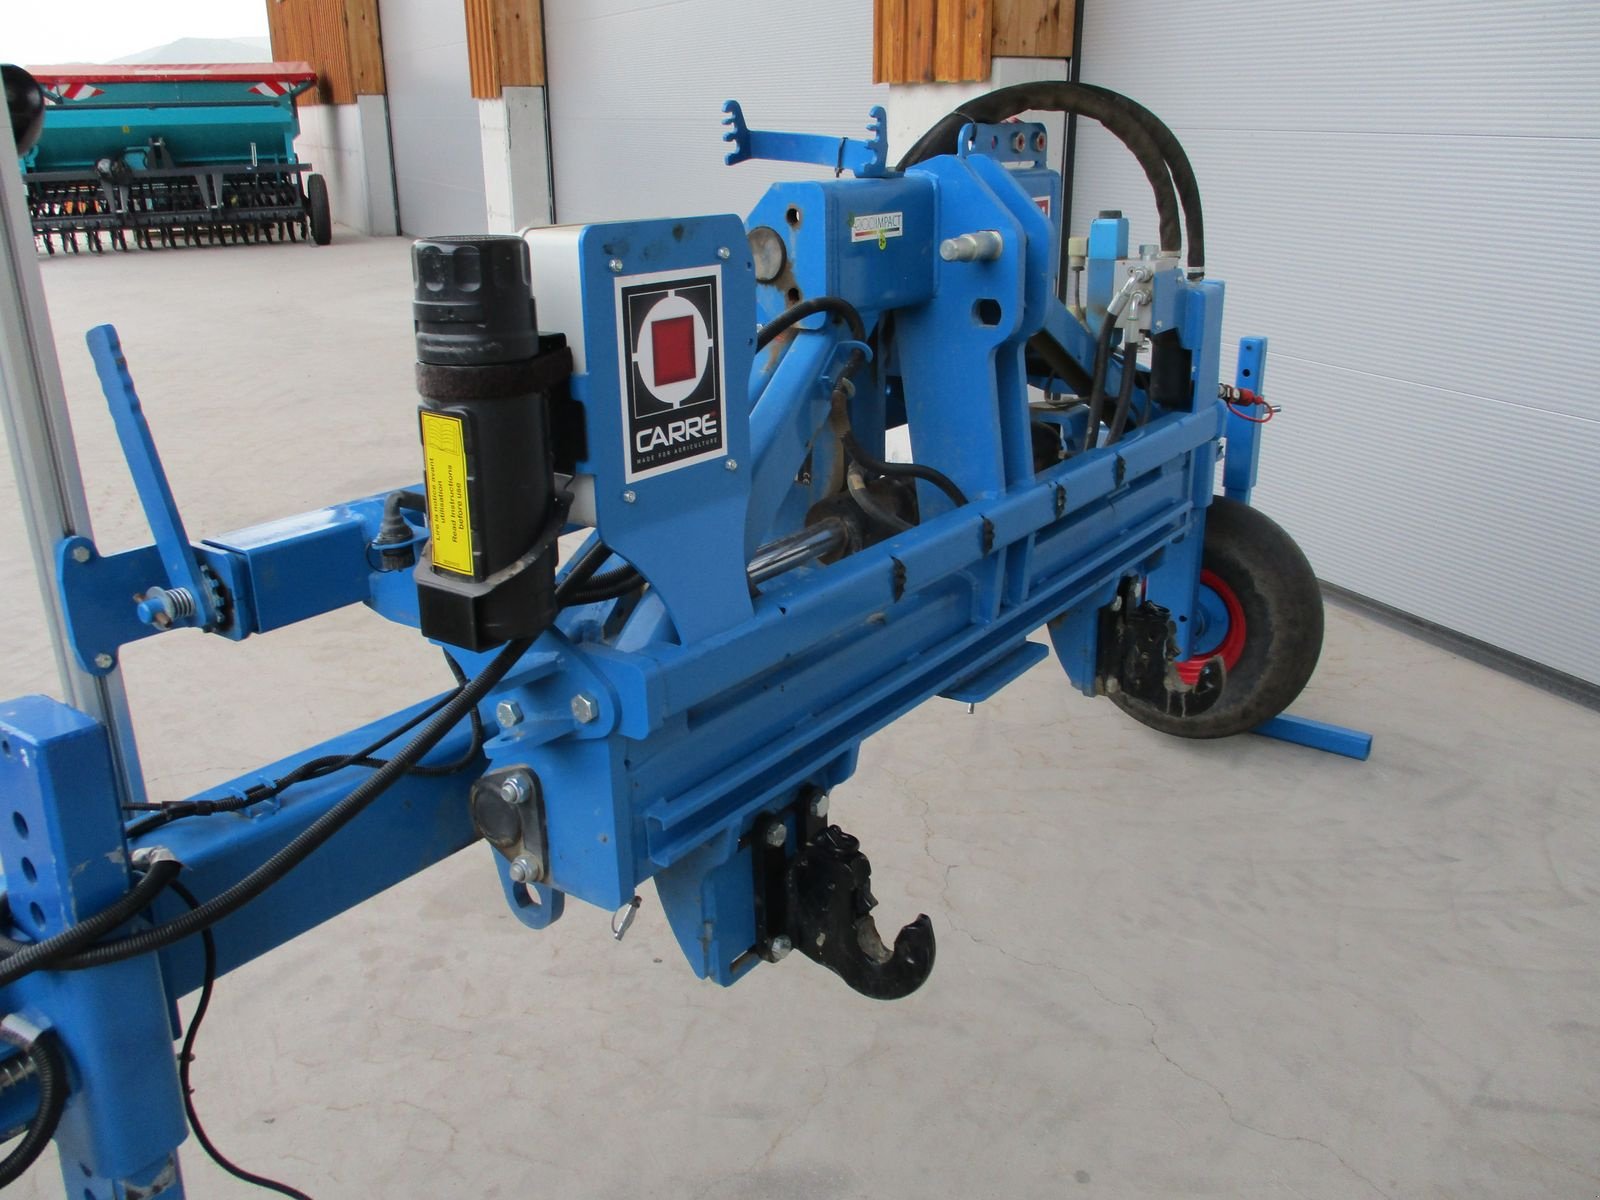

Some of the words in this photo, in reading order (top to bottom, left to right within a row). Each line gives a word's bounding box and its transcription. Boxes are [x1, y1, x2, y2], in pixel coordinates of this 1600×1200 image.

[636, 455, 655, 464] MADE
[674, 437, 718, 454] AGRICULTURE
[438, 481, 446, 524] utilisation
